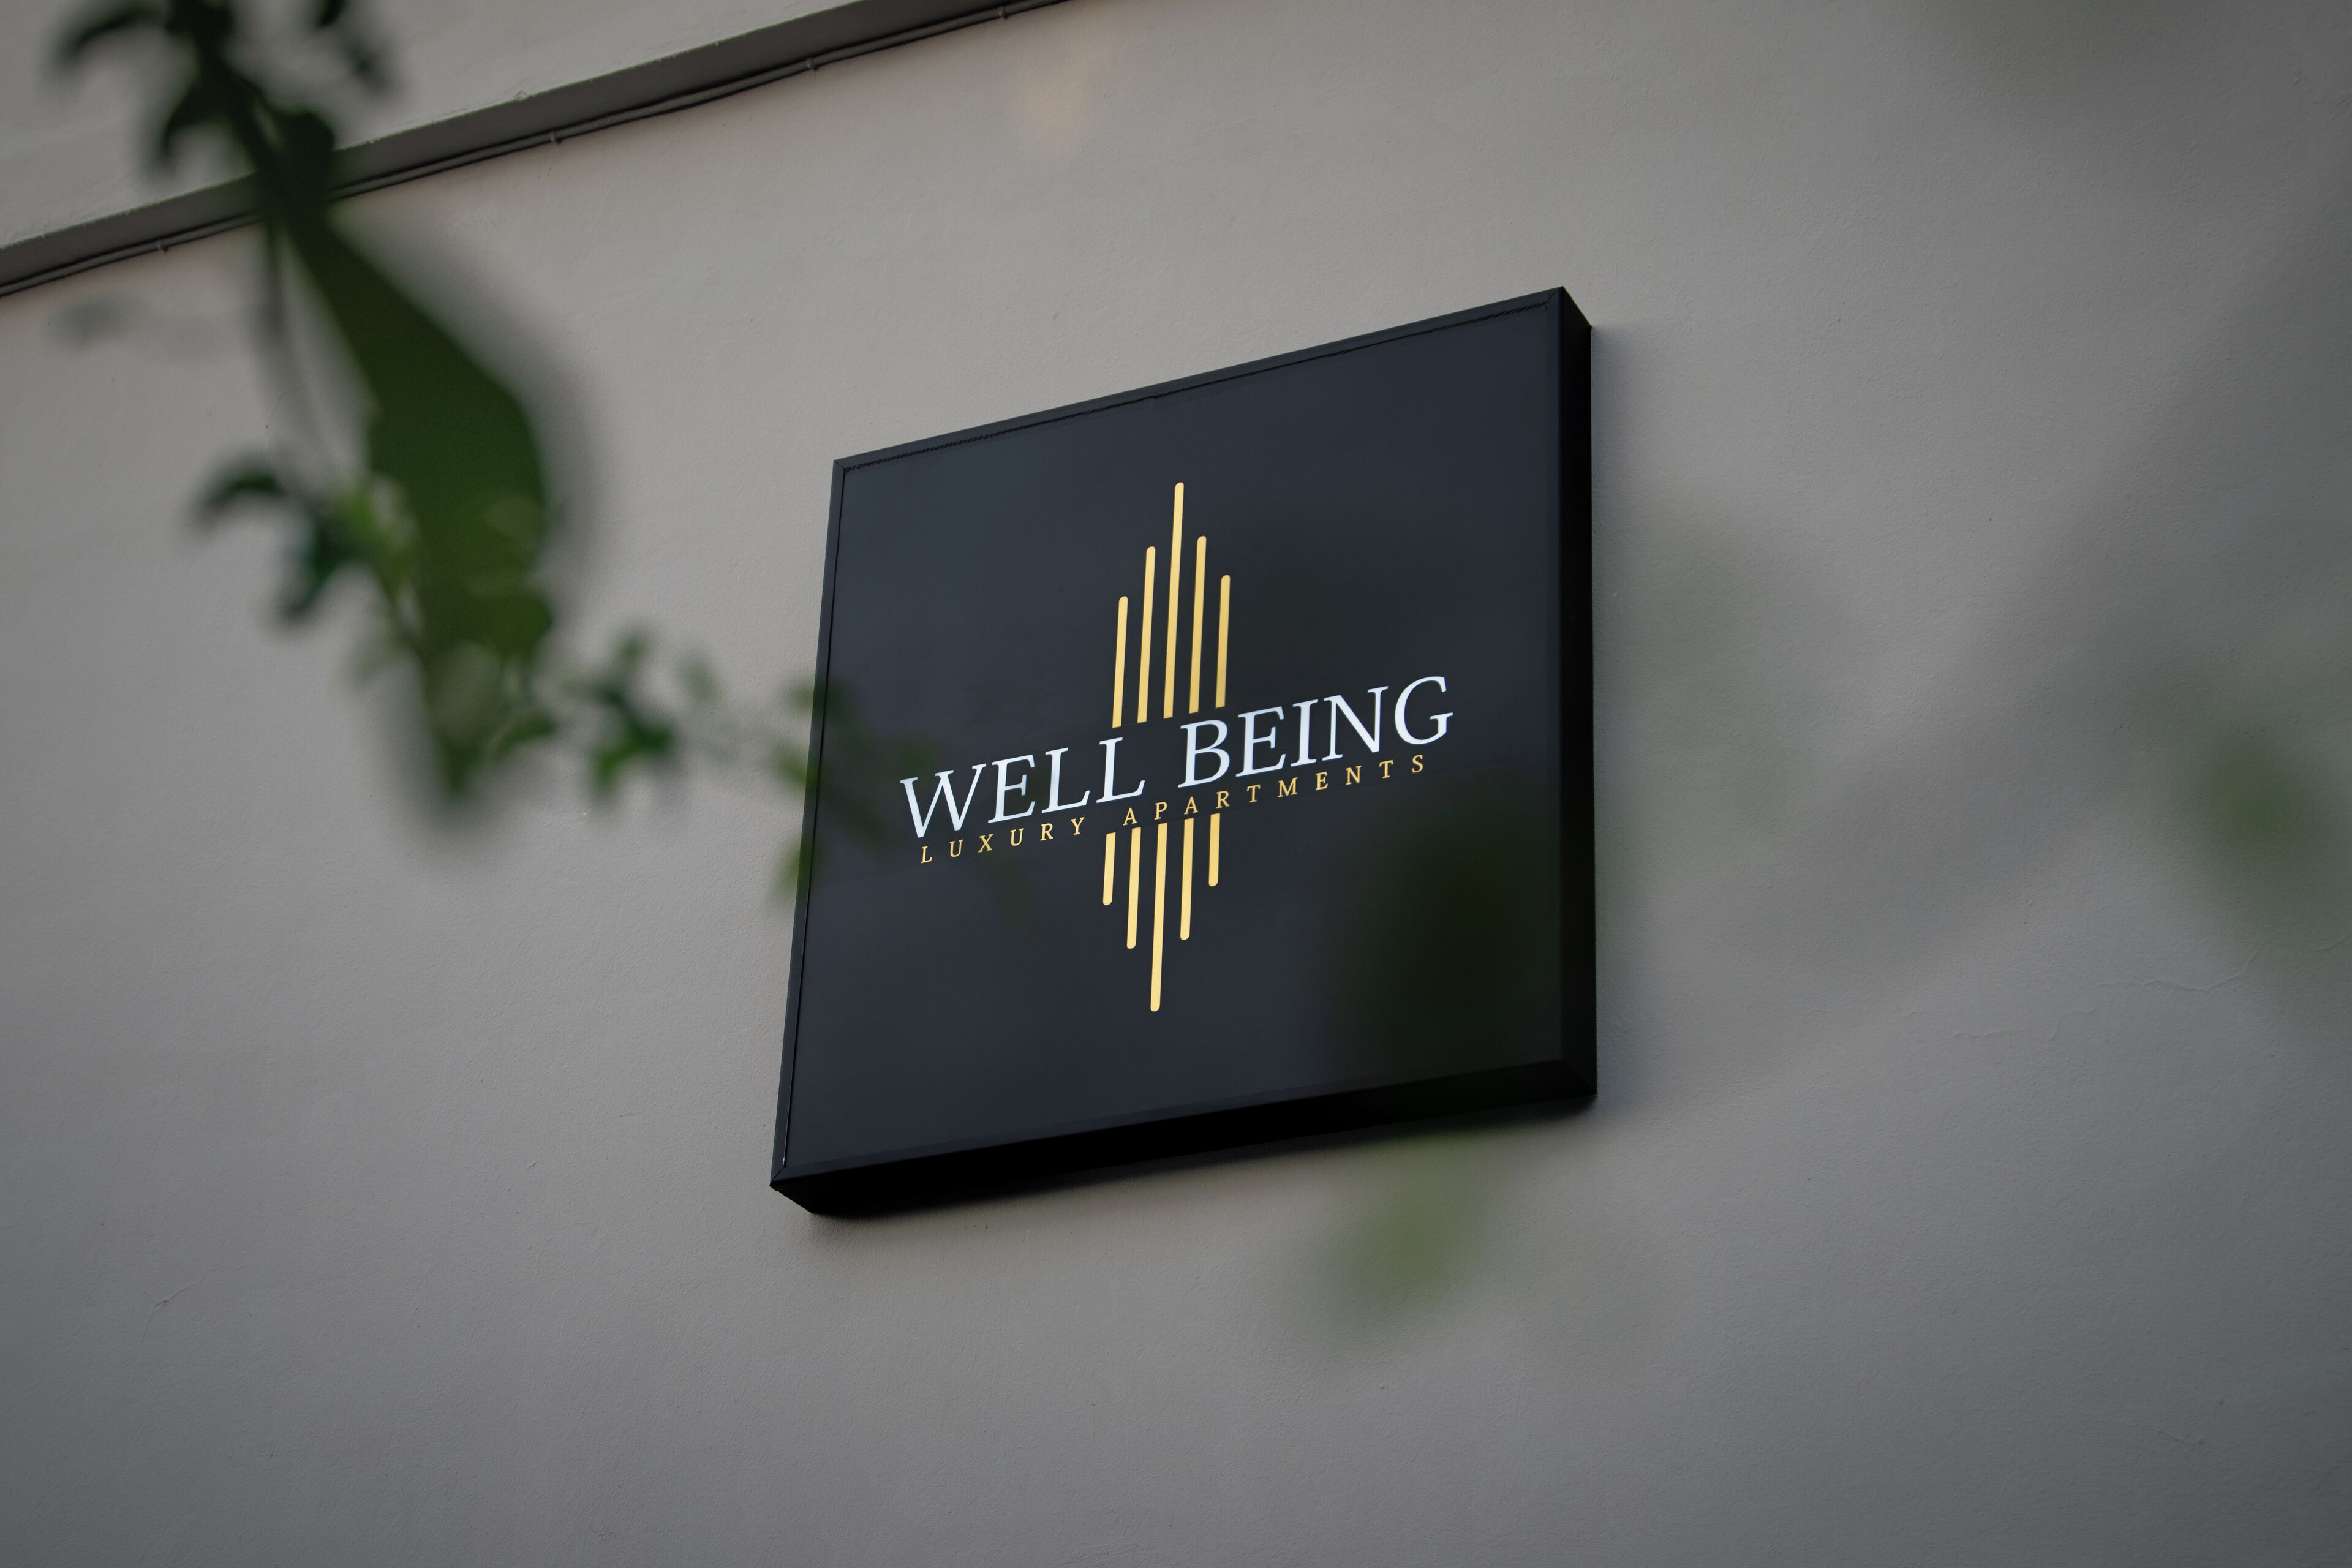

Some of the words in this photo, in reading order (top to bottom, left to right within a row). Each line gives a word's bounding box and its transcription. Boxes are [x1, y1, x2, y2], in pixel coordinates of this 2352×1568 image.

[900, 737, 1145, 839] WELL
[1177, 676, 1453, 788] BEING
[920, 816, 1085, 864] LUXURY
[1123, 754, 1425, 826] APARTMENTS
